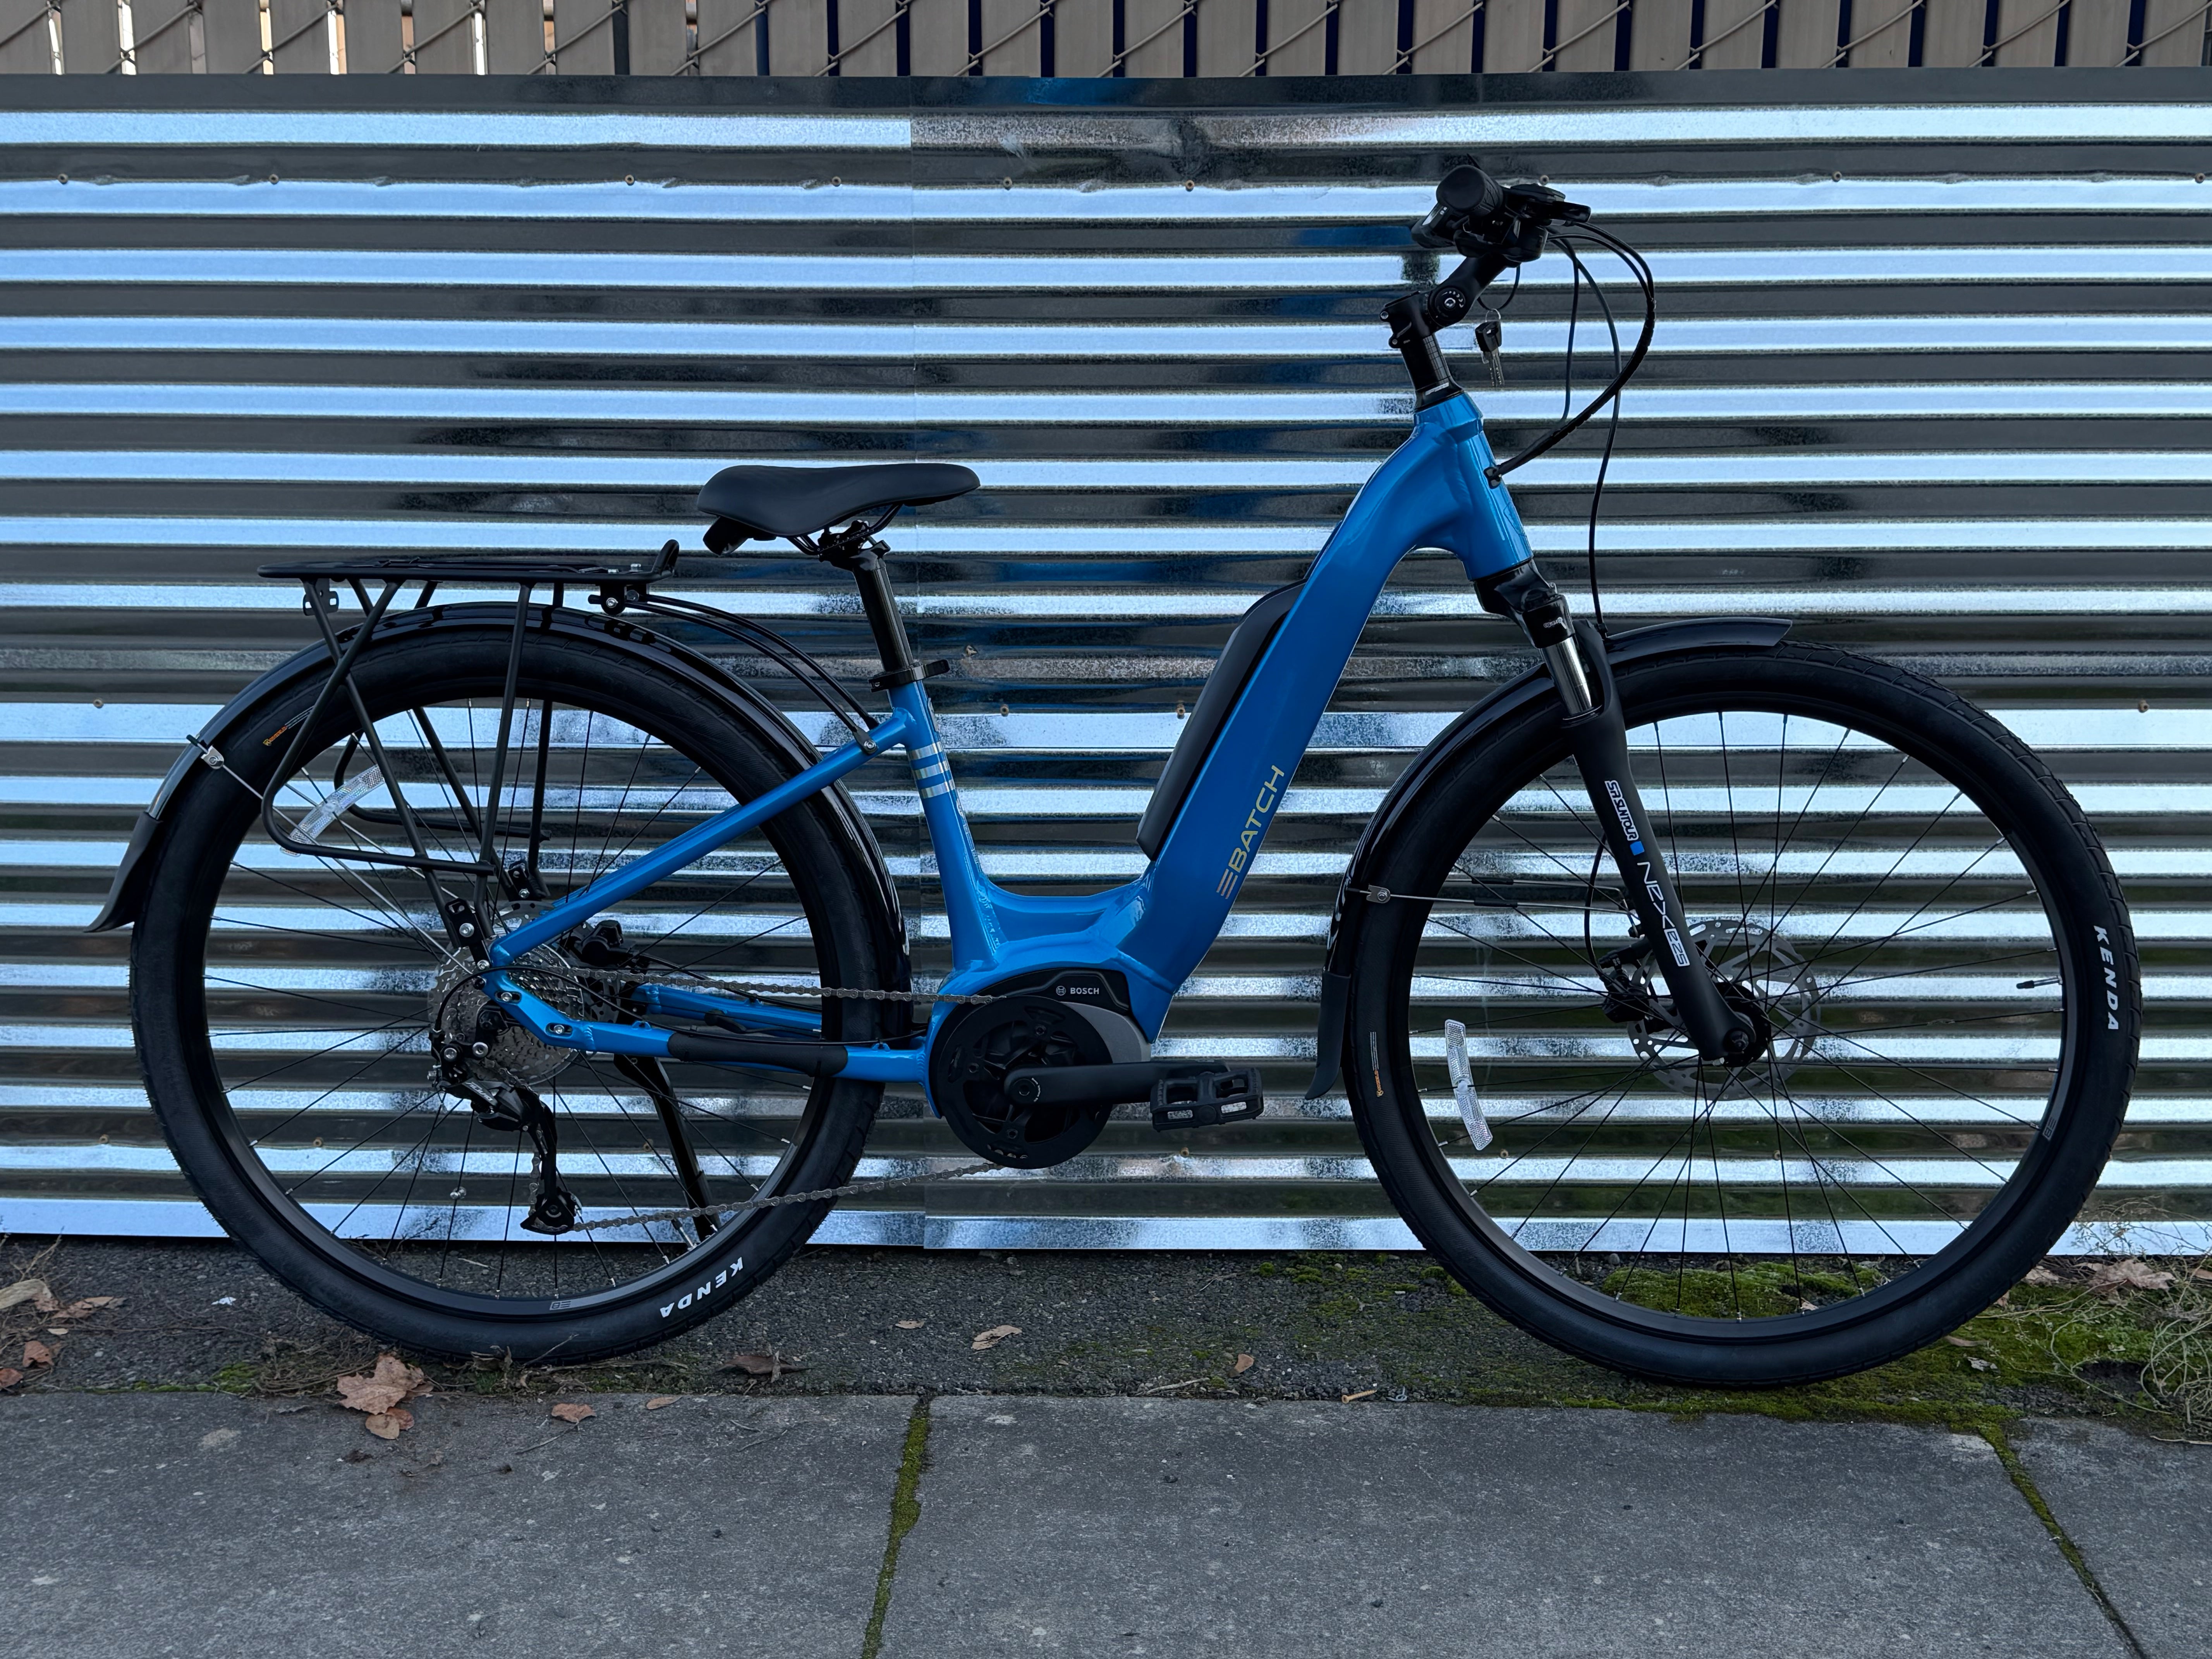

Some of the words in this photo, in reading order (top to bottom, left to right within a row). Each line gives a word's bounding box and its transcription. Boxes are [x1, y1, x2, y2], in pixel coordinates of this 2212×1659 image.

[1613, 798, 1638, 840] SUNTOUR
[2094, 925, 2119, 1030] KENDA
[660, 1257, 743, 1318] KENDA
